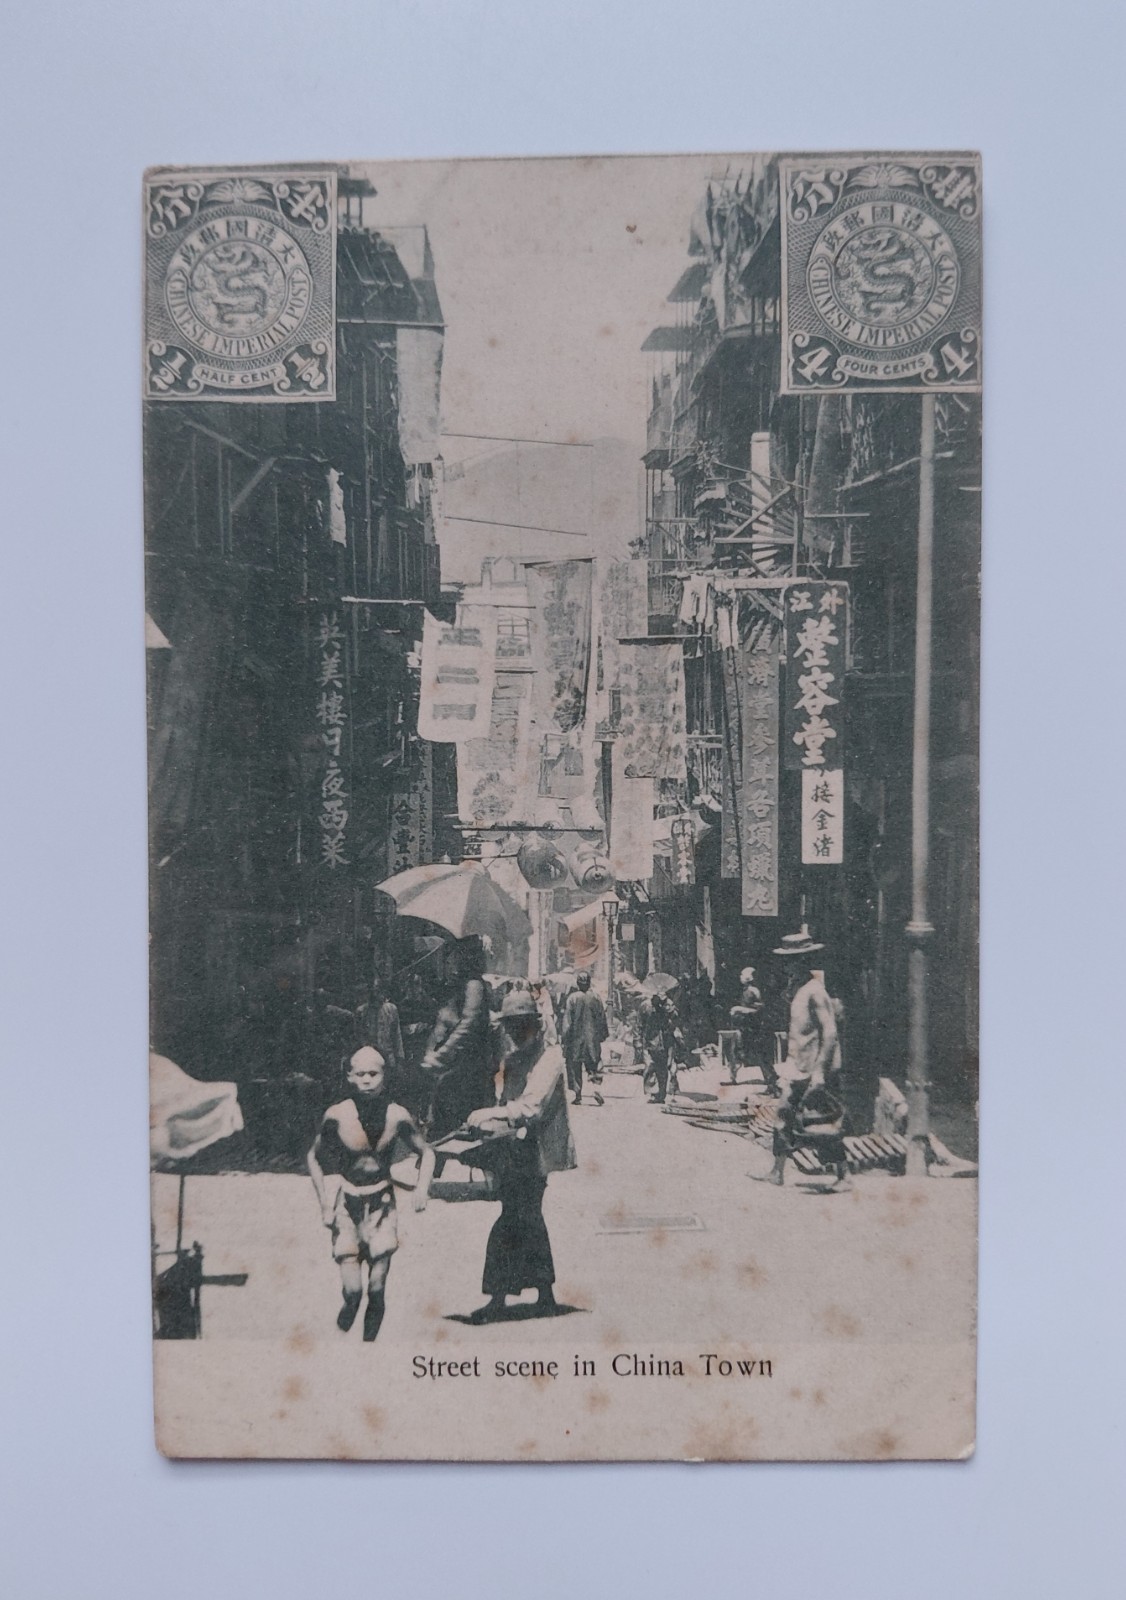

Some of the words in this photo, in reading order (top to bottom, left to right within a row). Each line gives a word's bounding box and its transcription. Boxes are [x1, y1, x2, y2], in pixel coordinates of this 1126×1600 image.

[287, 183, 324, 218] 半
[169, 278, 212, 345] CHINESE
[212, 321, 294, 355] IMPERIAL
[286, 277, 308, 321] POST
[811, 265, 856, 337] CHINESE
[856, 306, 942, 347] IMPERIAL
[936, 264, 956, 309] POST
[200, 369, 235, 384] HALF
[241, 367, 279, 384] CENT
[797, 347, 832, 382] 4
[843, 359, 878, 375] FOUR
[883, 357, 926, 375] CENTS
[940, 342, 974, 378] 4
[412, 1355, 480, 1379] Street
[495, 1359, 559, 1379] scene
[573, 1354, 596, 1376] in
[612, 1353, 685, 1377] China
[699, 1354, 773, 1378] Town
